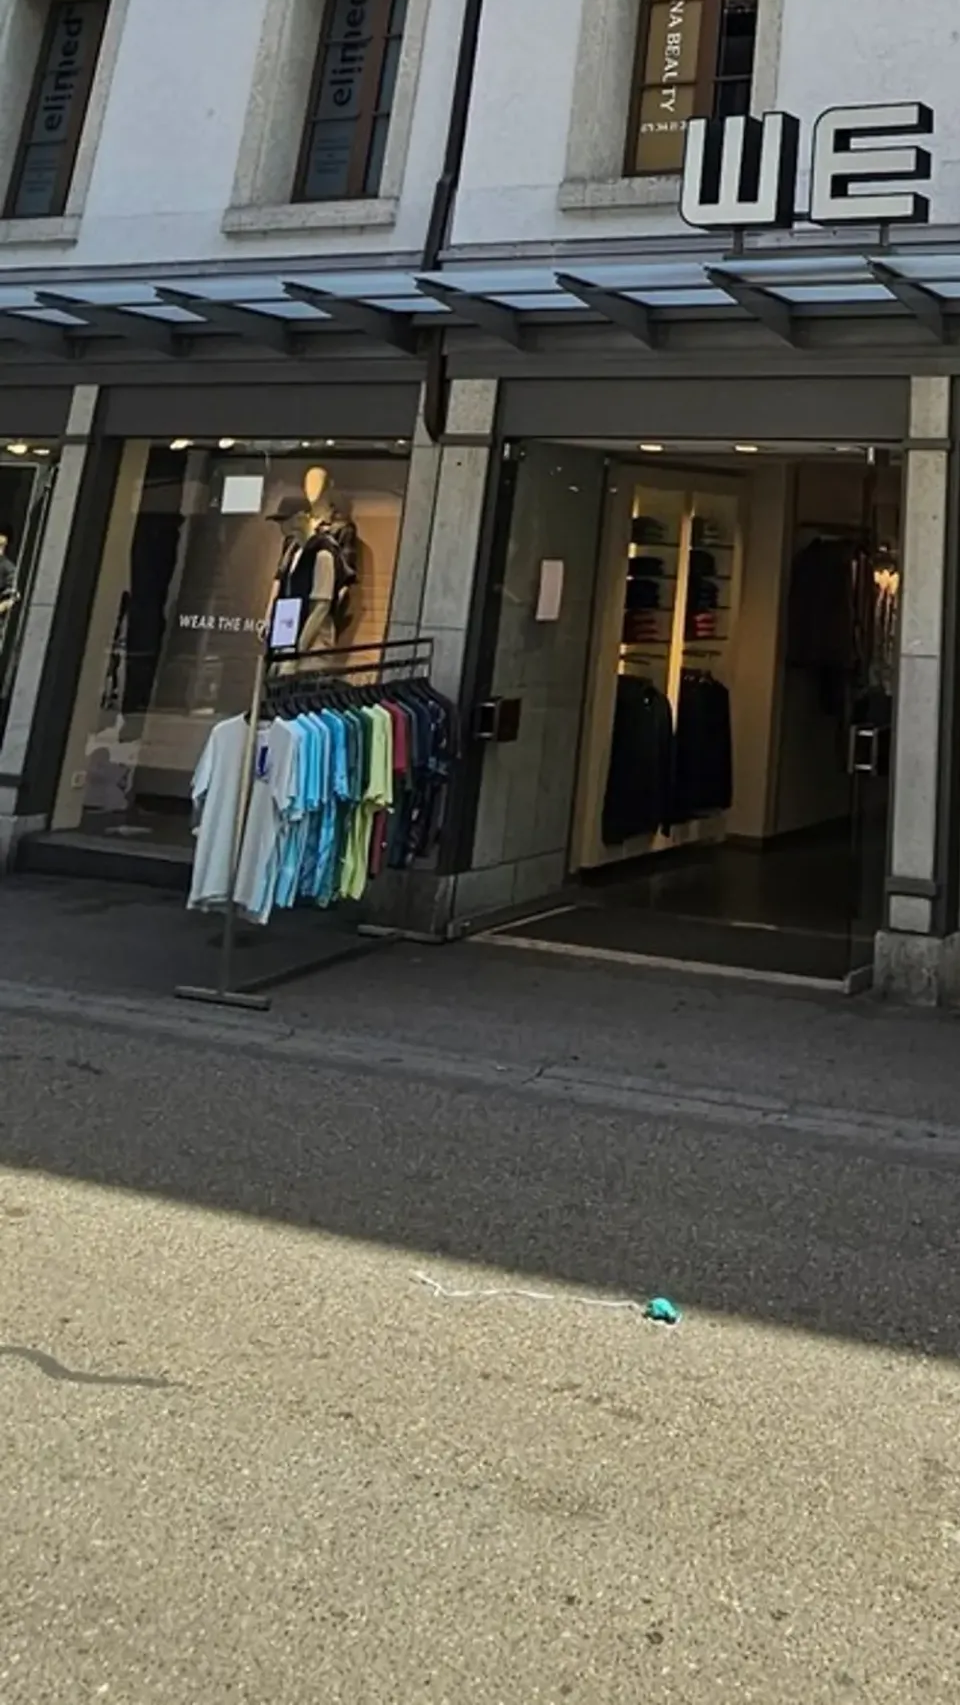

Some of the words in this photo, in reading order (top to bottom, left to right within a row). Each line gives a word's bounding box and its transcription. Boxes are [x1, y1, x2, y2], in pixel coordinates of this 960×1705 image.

[42, 16, 83, 132] elimed
[680, 101, 934, 230] WE
[179, 614, 216, 630] WEAR
[218, 616, 240, 631] THE
